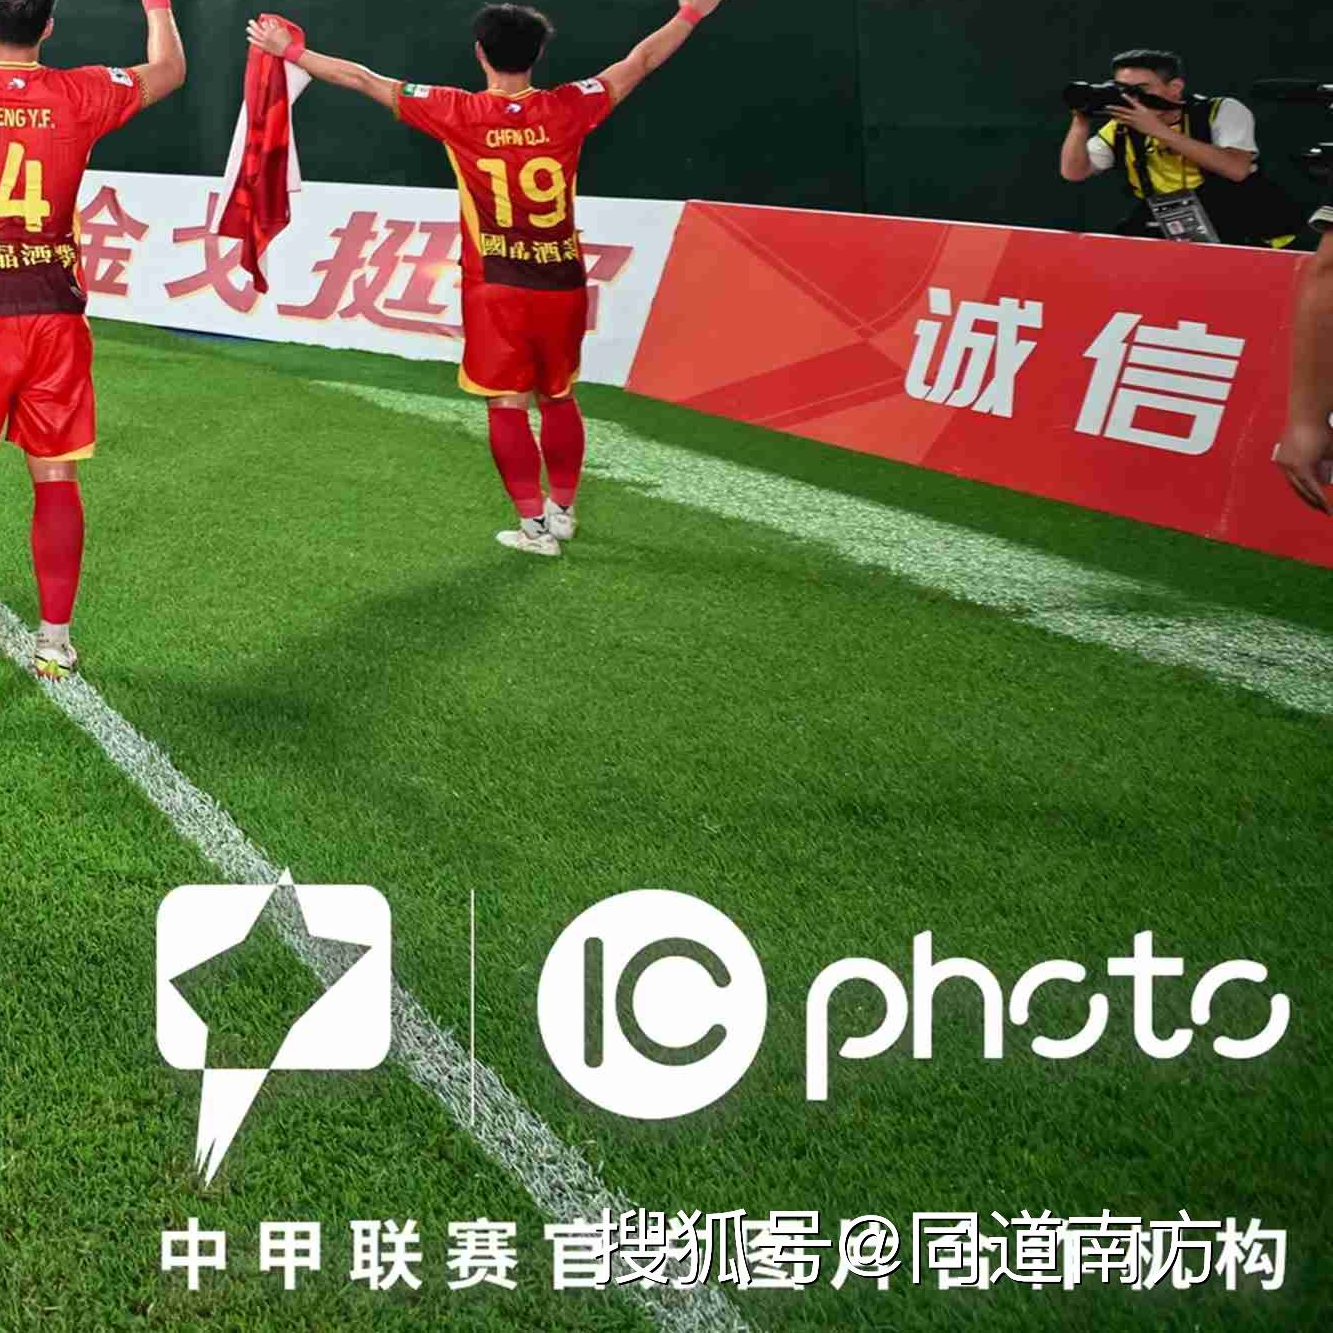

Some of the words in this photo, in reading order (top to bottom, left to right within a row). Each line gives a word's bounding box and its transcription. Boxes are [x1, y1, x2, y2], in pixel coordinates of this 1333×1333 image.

[26, 108, 56, 129] Y.F.
[476, 156, 567, 229] 19
[903, 286, 1246, 456] 诚信
